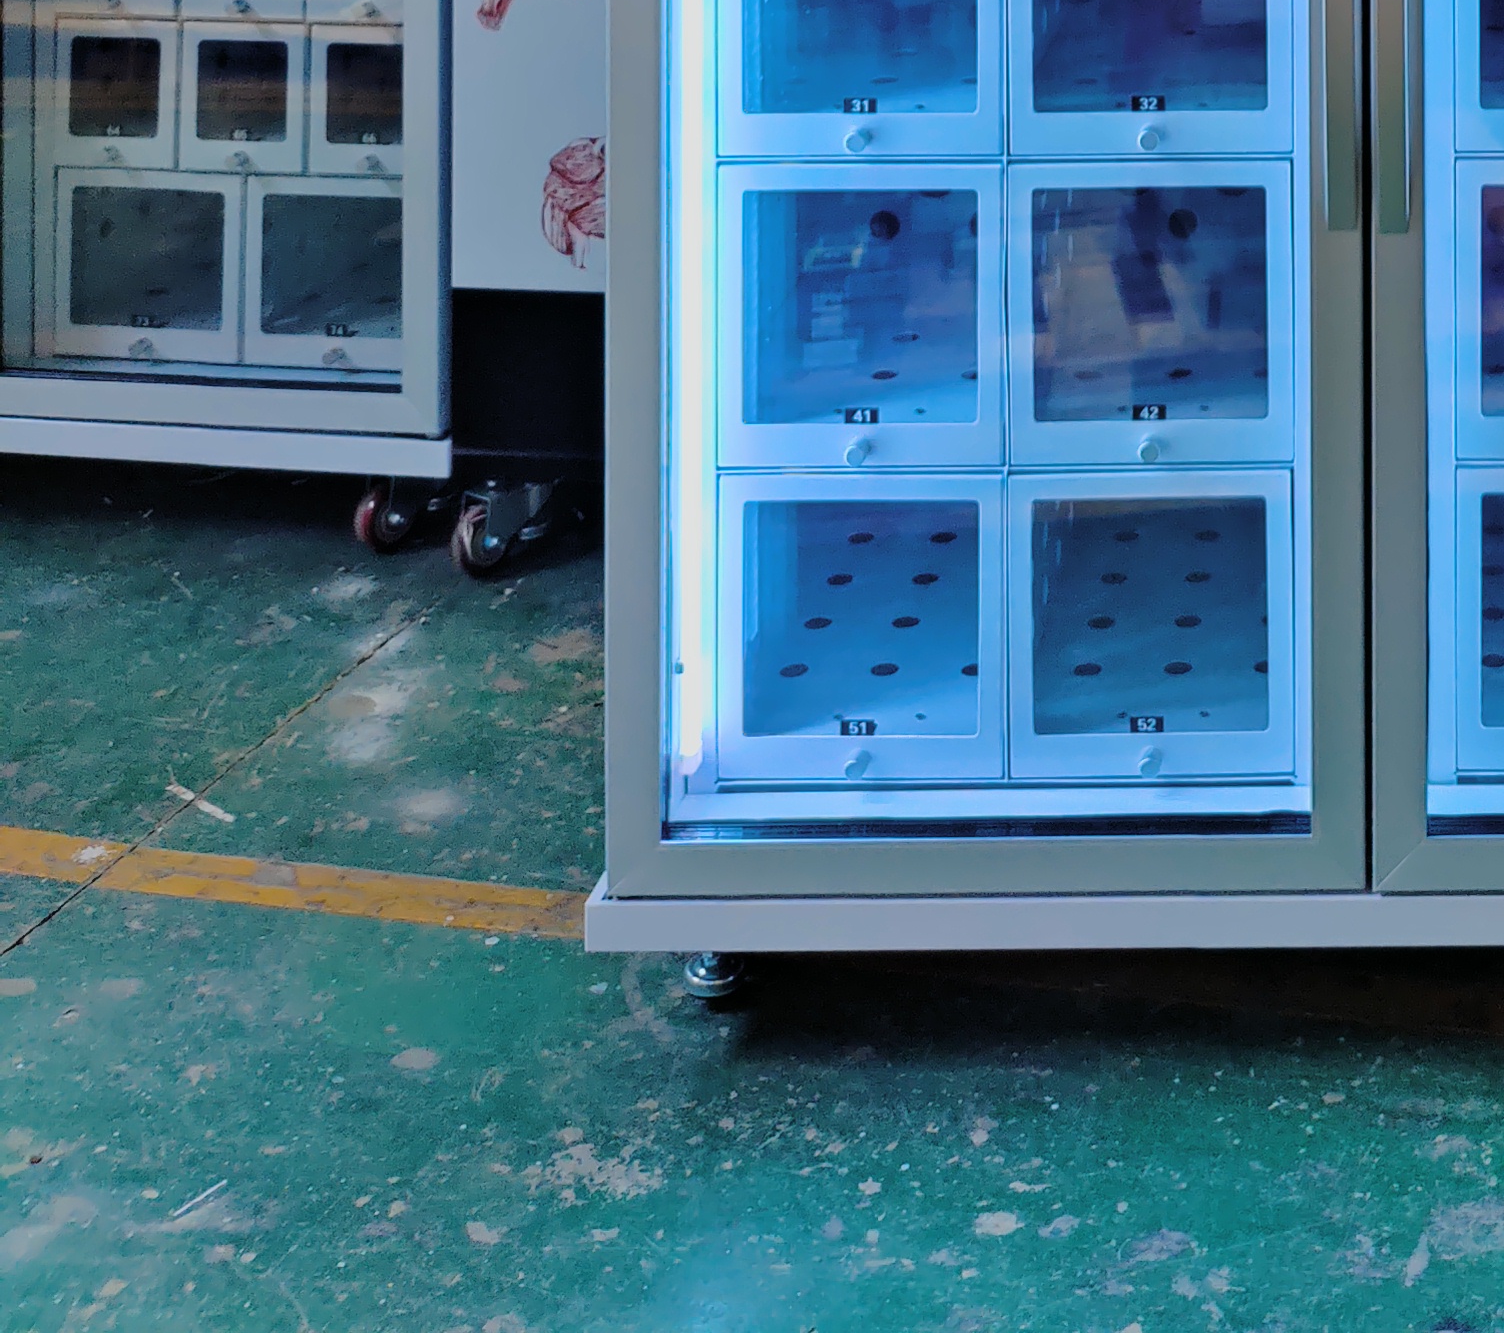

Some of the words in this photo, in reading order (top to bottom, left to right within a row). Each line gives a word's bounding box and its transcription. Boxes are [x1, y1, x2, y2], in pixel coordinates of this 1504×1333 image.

[852, 100, 869, 112] 31
[1139, 97, 1158, 110] 32
[853, 410, 871, 422] 41
[1140, 406, 1159, 419] 42
[849, 722, 867, 734] 51
[1137, 718, 1156, 731] 52
